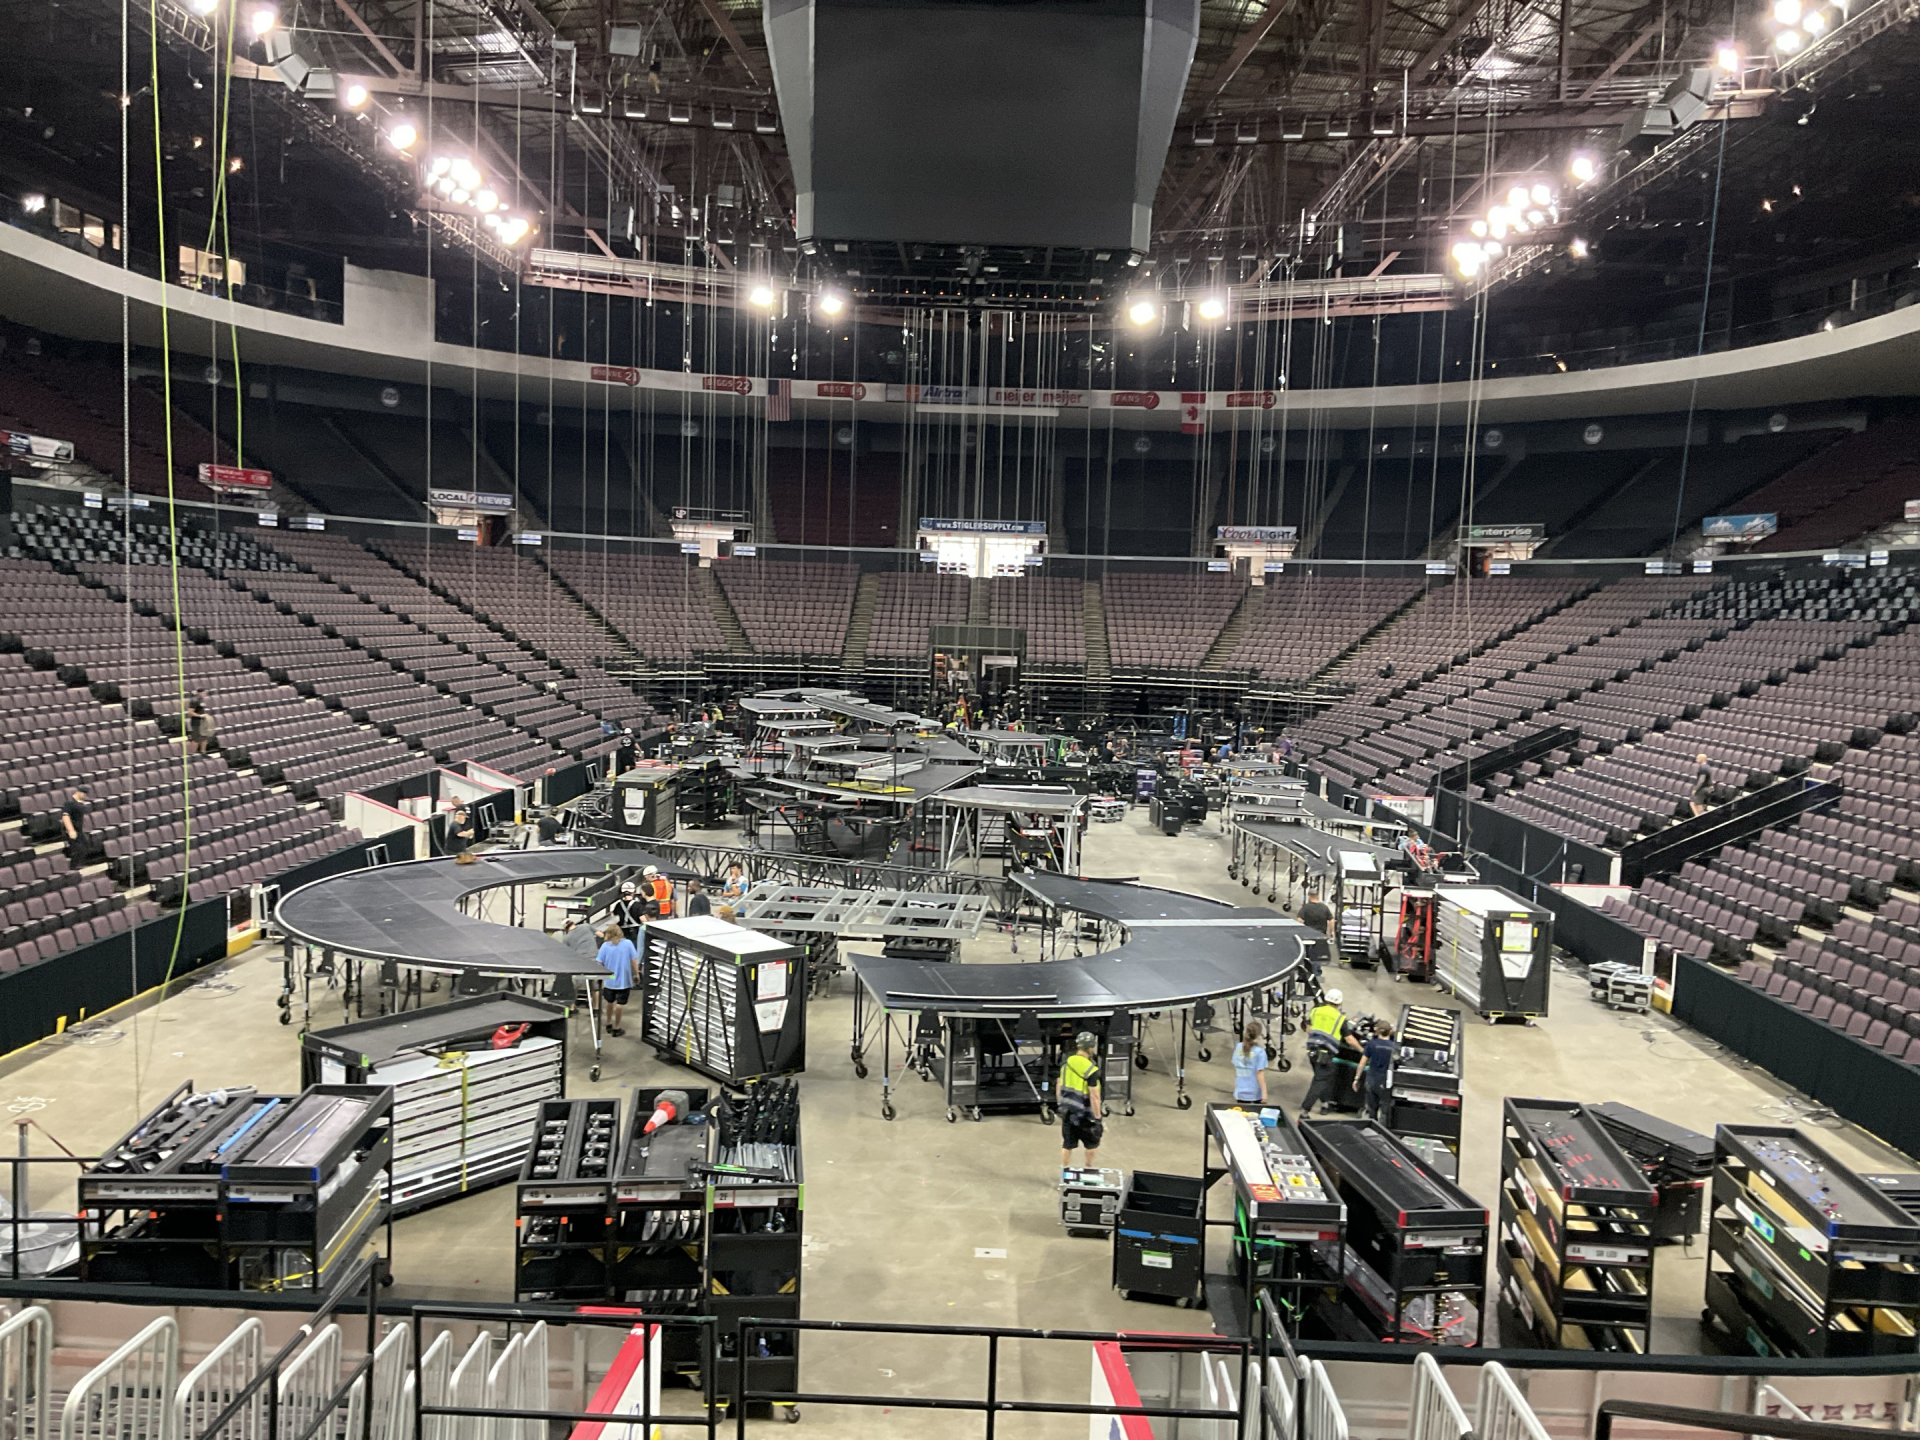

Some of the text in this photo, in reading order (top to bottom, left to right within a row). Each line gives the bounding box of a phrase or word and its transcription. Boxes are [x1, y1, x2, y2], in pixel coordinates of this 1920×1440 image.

[625, 371, 638, 381] 21
[736, 380, 750, 390] 22
[823, 385, 846, 393] ROSE
[996, 389, 1083, 406] meijer meijer
[1115, 394, 1140, 403] FANS
[430, 492, 467, 502] LOCAL
[478, 495, 511, 506] NEWS
[1221, 526, 1291, 539] Coors LIGHT
[1471, 527, 1533, 537] enterprise
